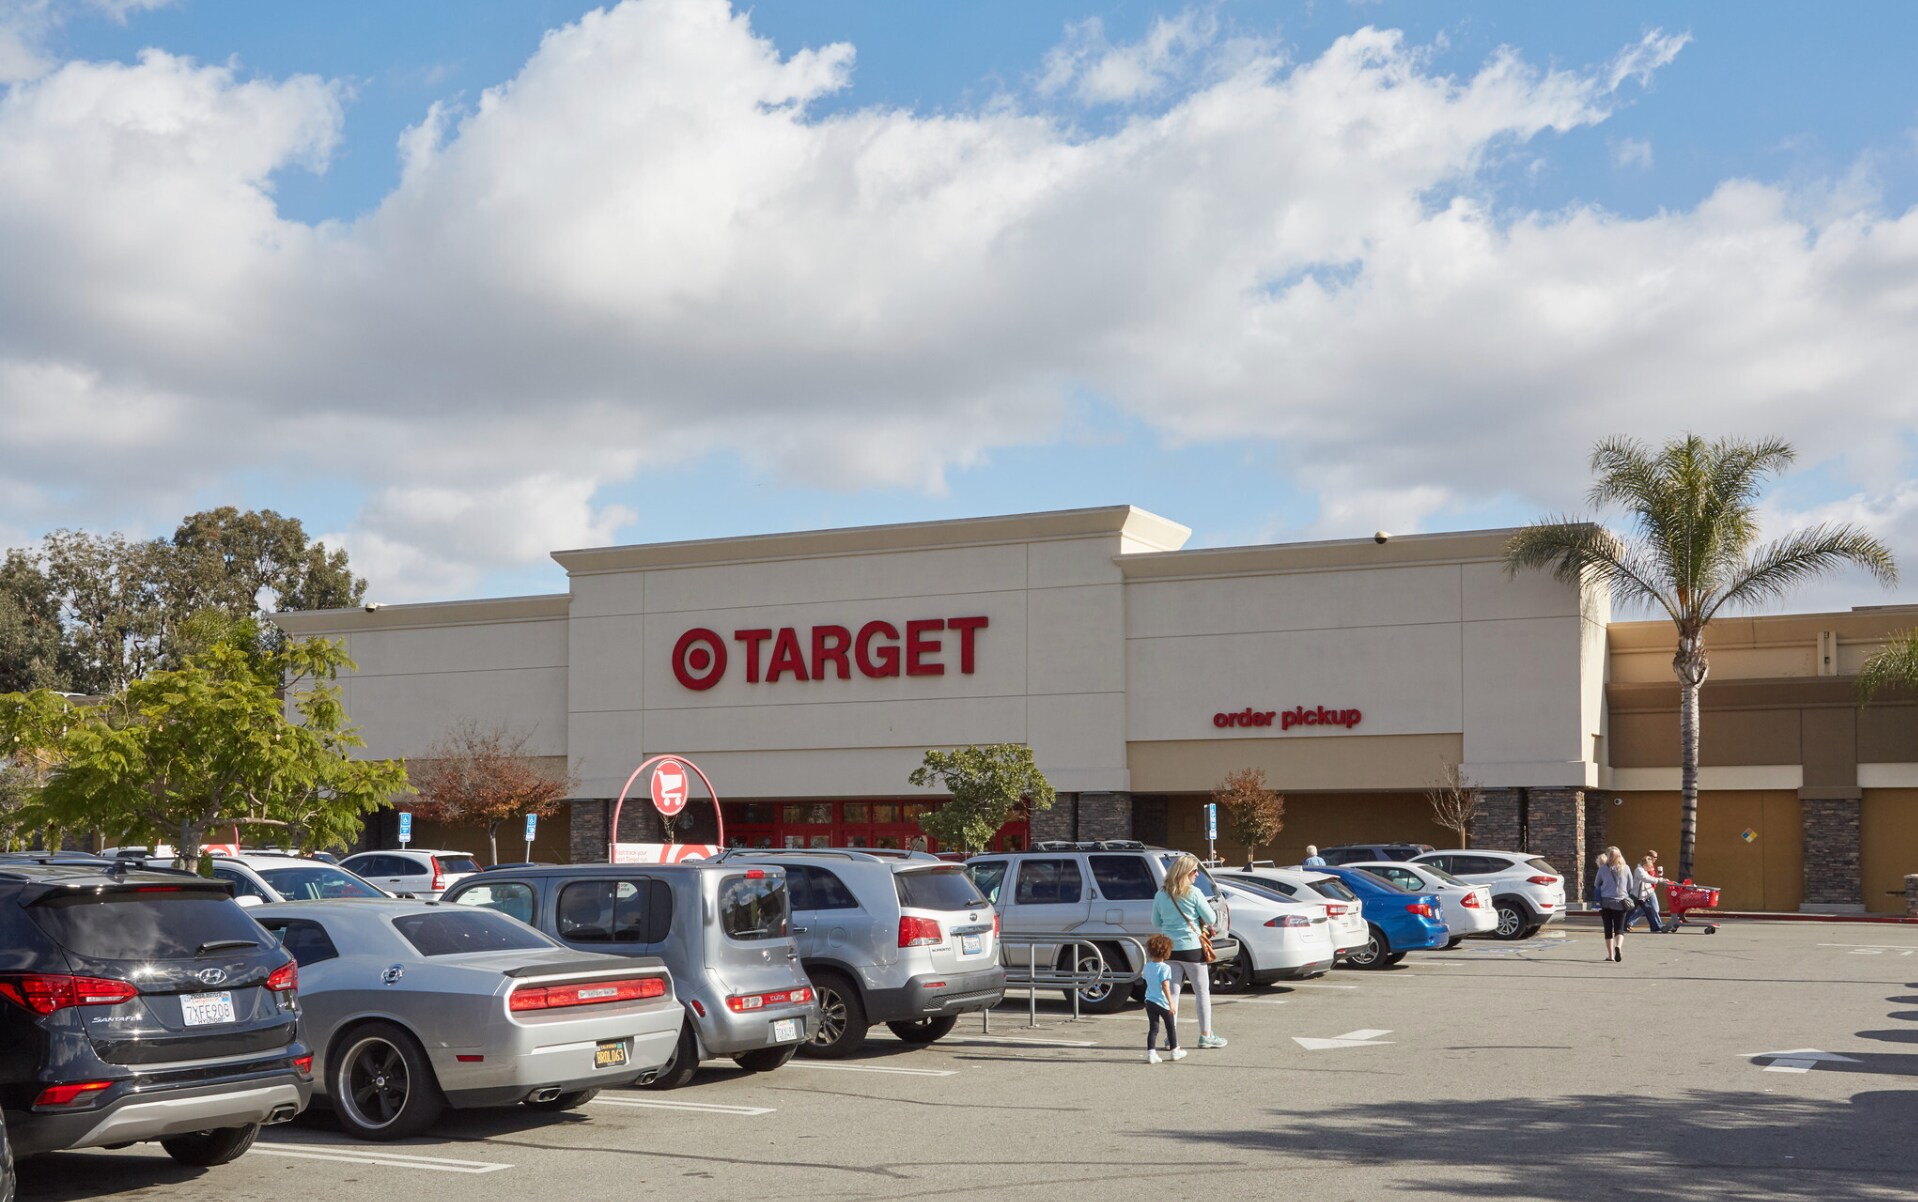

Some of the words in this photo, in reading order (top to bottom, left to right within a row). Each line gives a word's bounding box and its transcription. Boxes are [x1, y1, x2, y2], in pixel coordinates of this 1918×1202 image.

[734, 616, 988, 683] TARGET
[1213, 707, 1276, 728] order
[1281, 705, 1362, 731] pickup
[186, 1003, 230, 1020] 7XFE908
